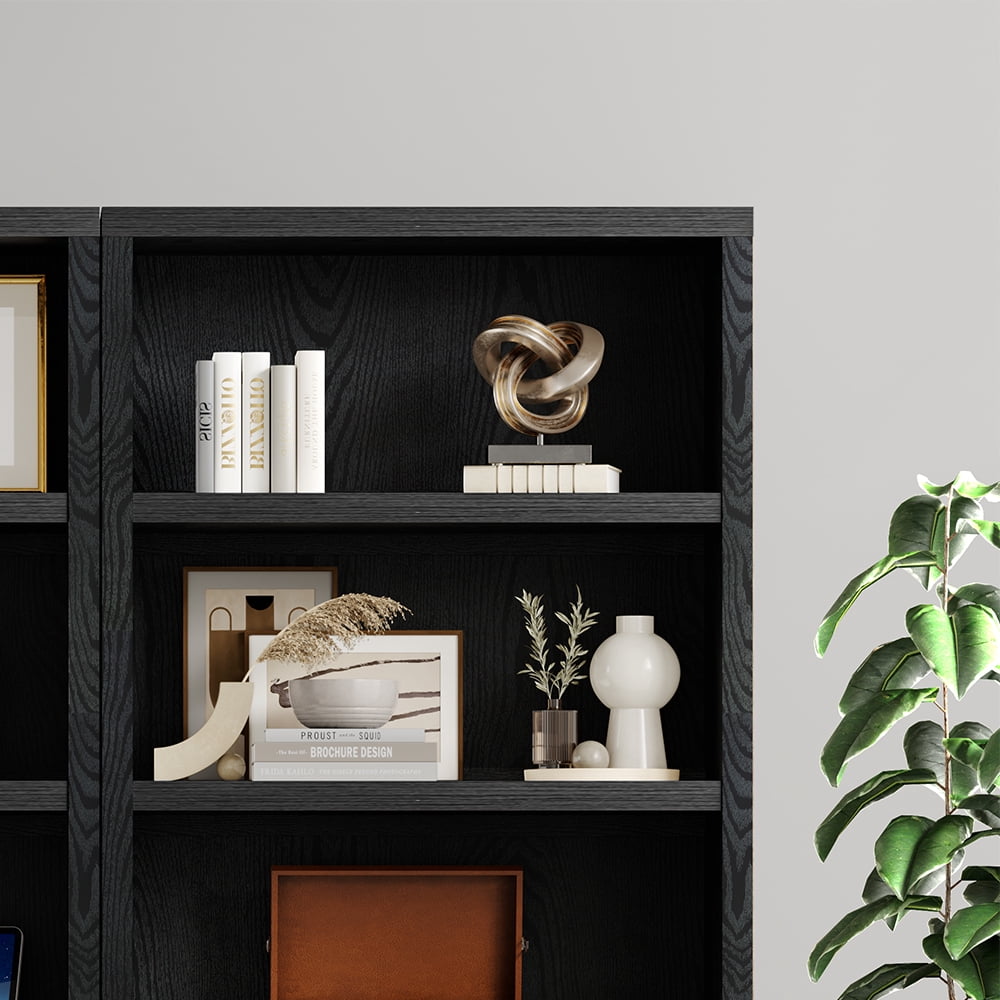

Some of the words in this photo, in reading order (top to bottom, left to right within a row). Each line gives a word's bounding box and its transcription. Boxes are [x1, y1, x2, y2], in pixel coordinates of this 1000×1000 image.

[300, 731, 337, 740] PROUST
[359, 731, 381, 741] SQUID
[310, 746, 358, 758] BROCHURE
[360, 746, 393, 758] DESIGN
